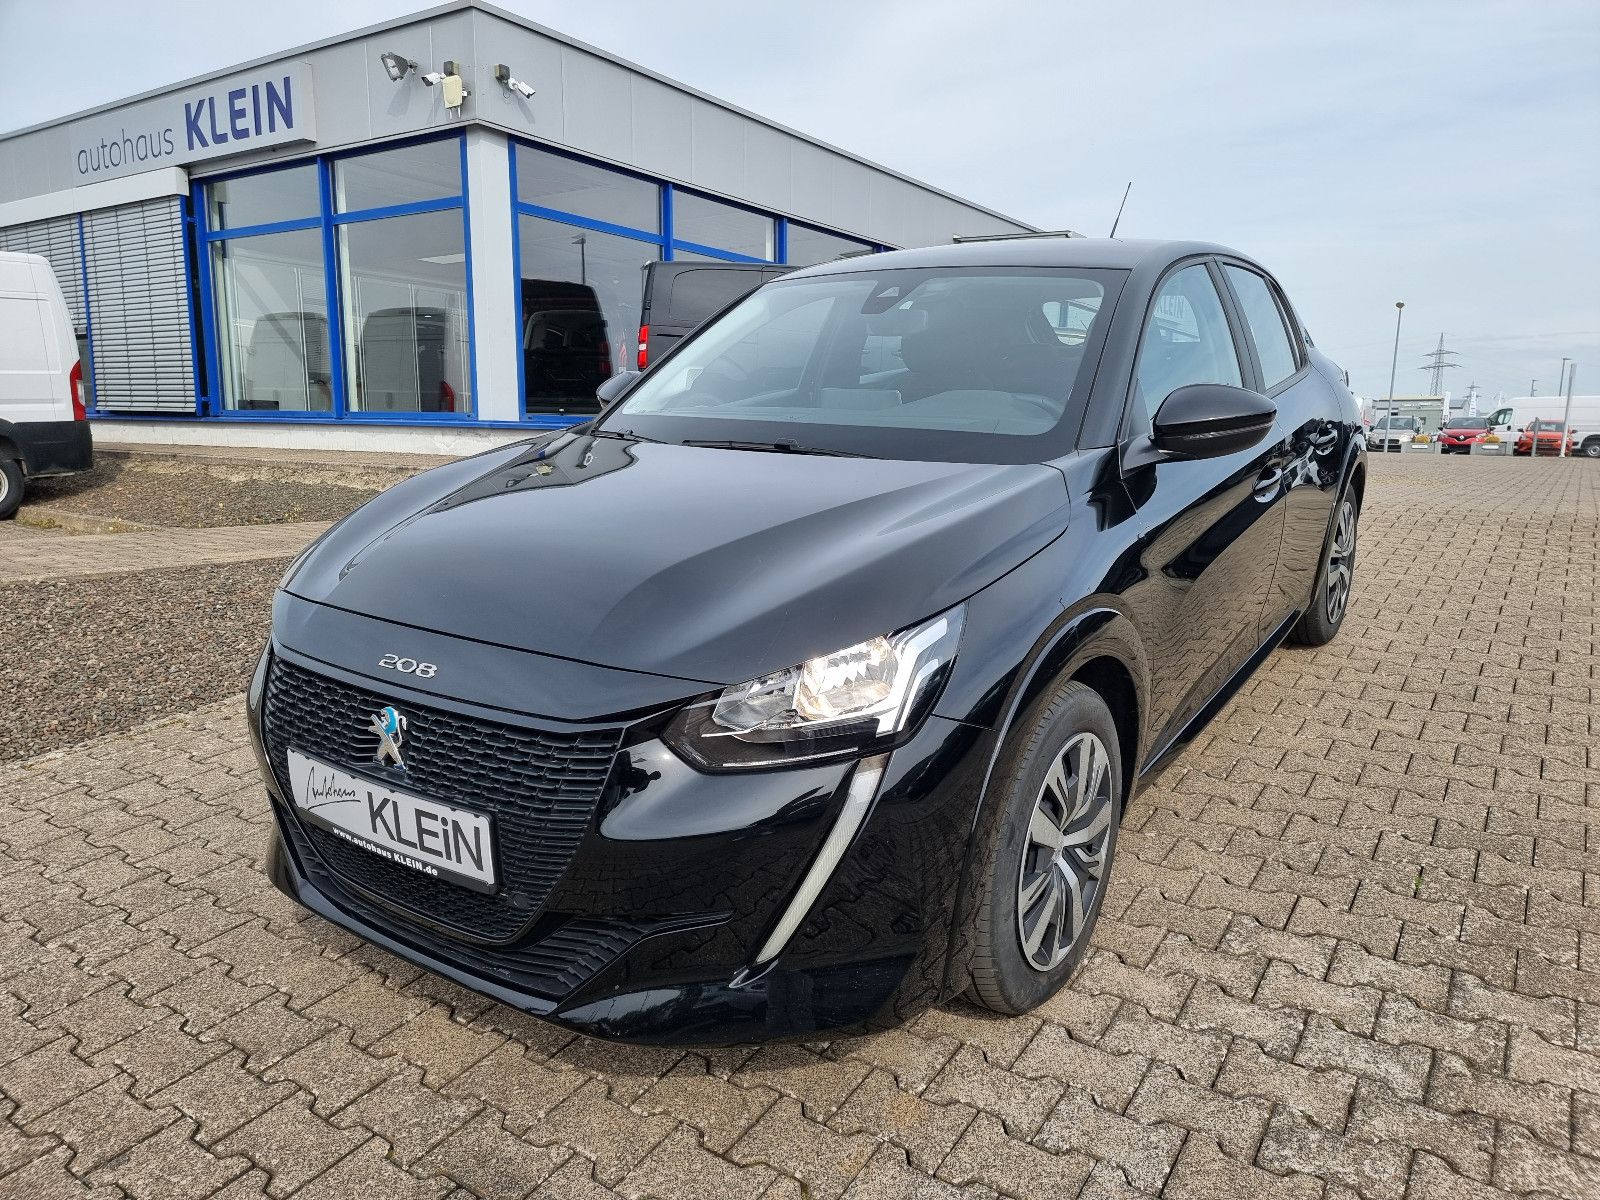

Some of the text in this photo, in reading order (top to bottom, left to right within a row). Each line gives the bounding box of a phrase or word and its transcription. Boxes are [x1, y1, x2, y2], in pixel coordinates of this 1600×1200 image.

[77, 75, 294, 174] autohaus KLEIN
[378, 653, 438, 679] 208
[332, 826, 438, 876] www.autohaus KLEIN.de
